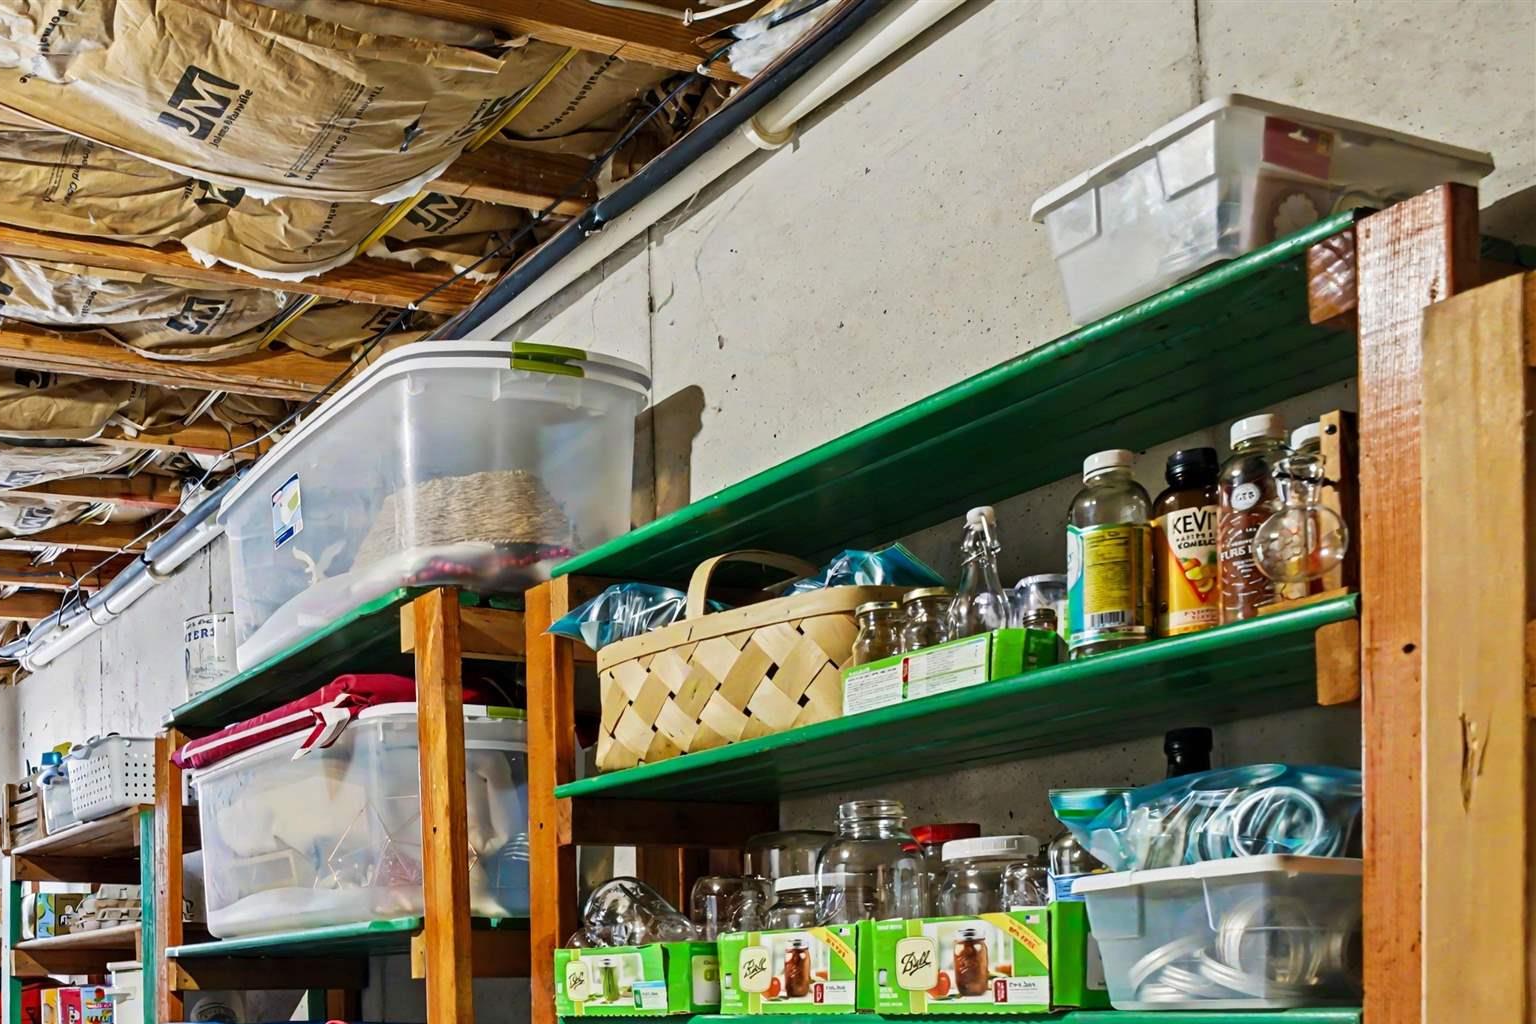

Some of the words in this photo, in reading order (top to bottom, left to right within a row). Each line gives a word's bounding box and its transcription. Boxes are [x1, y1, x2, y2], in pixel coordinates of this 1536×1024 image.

[157, 65, 240, 141] JM
[1172, 510, 1217, 535] KEVI
[901, 950, 932, 977] Ball
